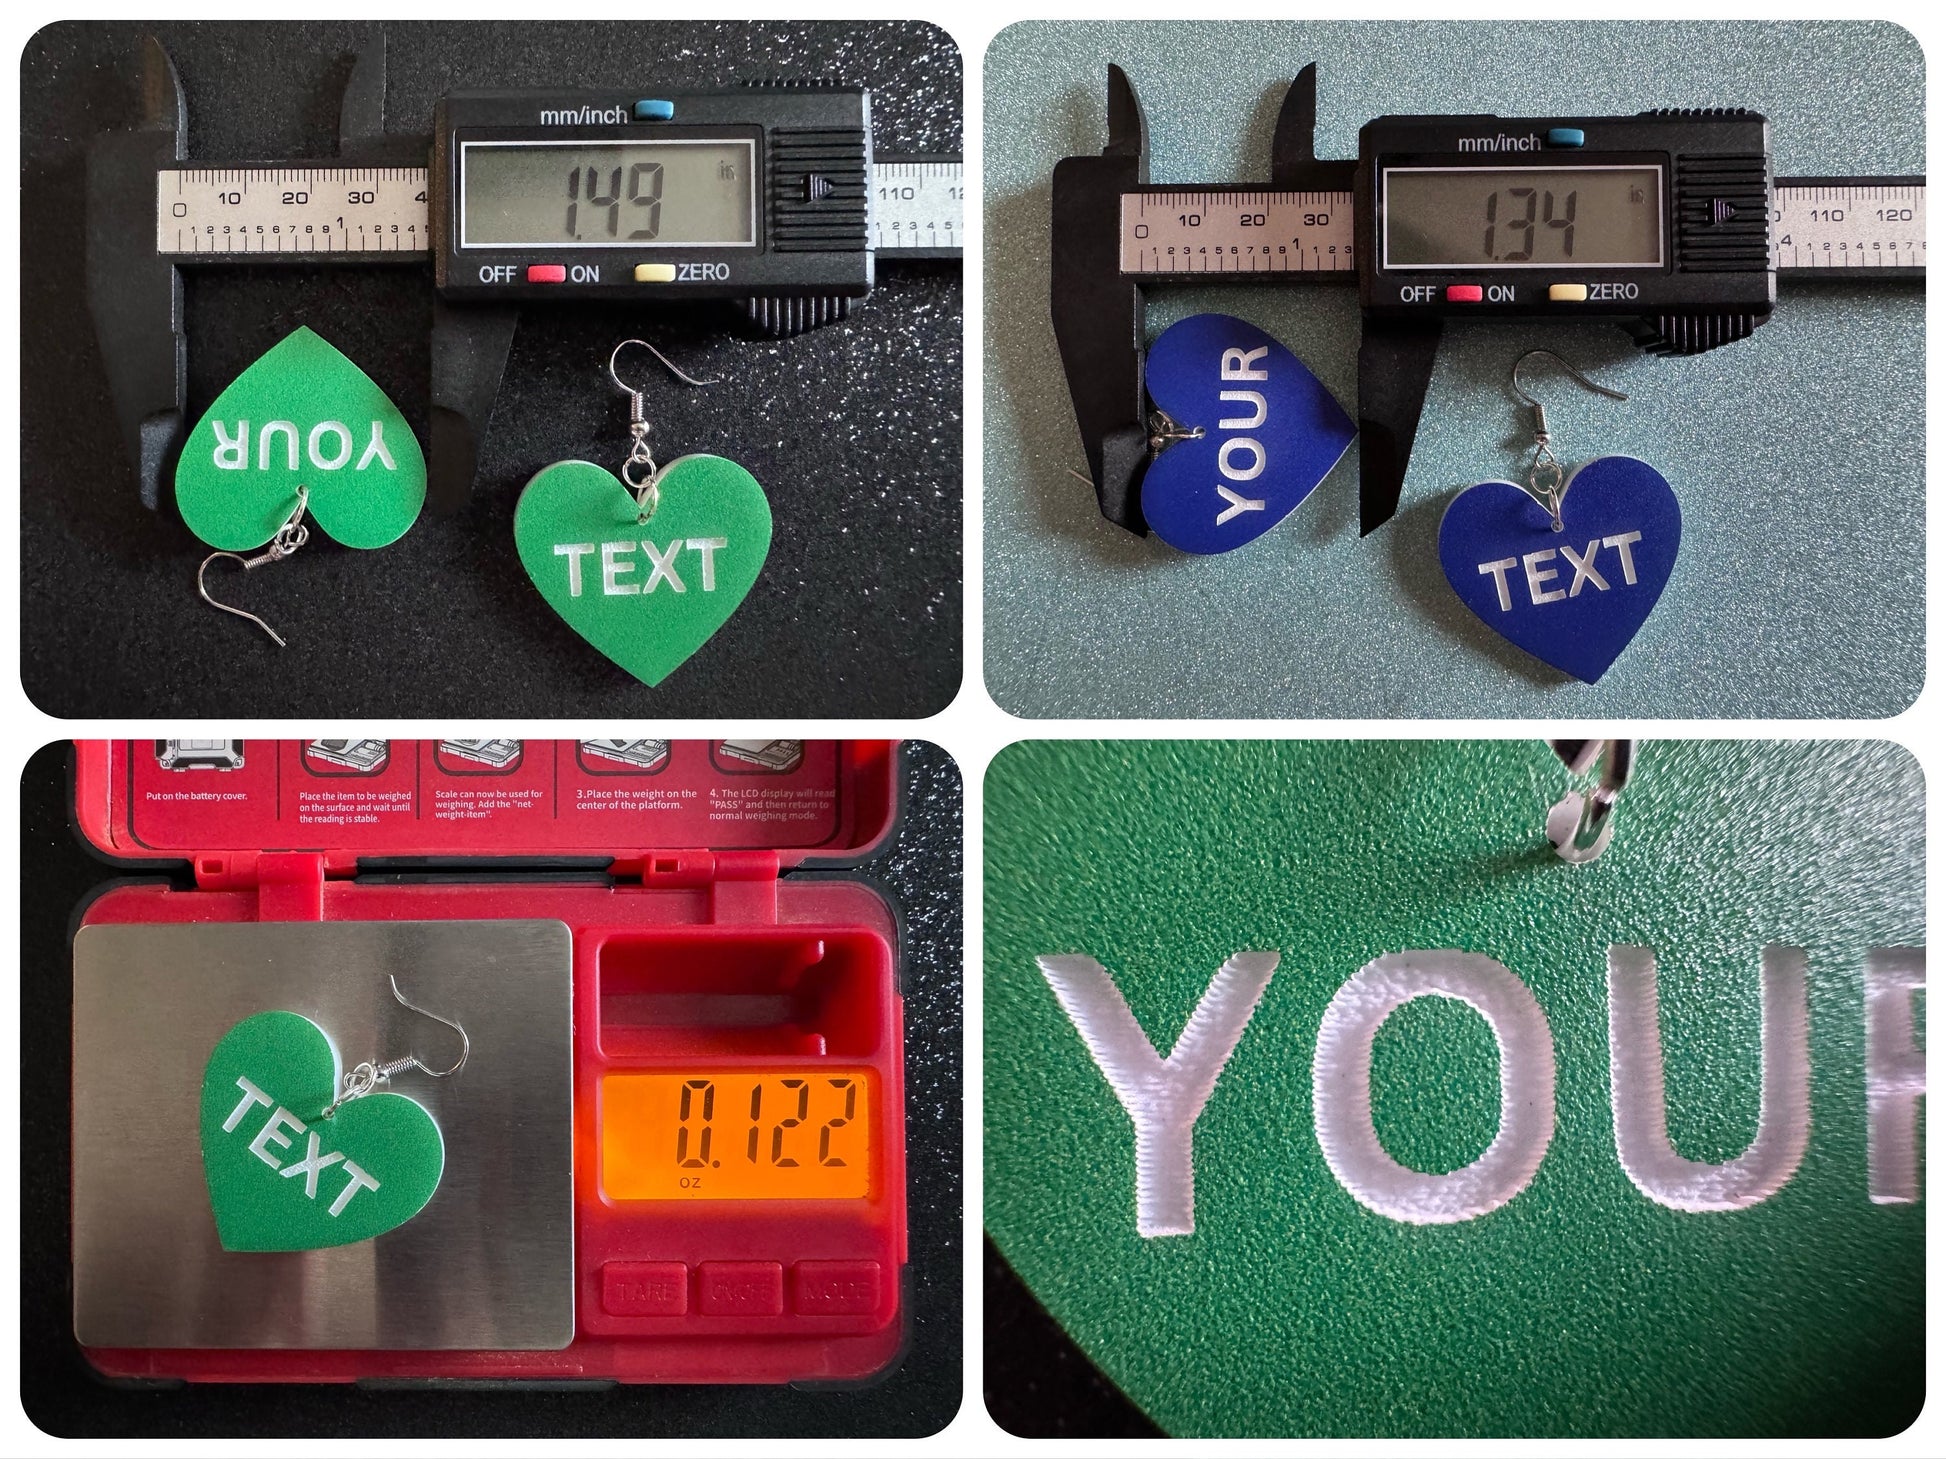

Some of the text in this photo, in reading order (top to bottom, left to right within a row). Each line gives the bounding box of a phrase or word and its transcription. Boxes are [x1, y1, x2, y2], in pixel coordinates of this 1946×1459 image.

[541, 105, 628, 126] mm/inch
[1458, 134, 1542, 152] mm/inch
[218, 192, 242, 205] 10
[282, 191, 309, 205] 20
[348, 191, 375, 204] 30
[879, 187, 915, 201] 110
[566, 162, 664, 240] 1.49
[172, 202, 187, 218] 0
[1810, 209, 1913, 222] 110 120
[337, 216, 344, 230] 1
[875, 221, 881, 230] 1
[892, 221, 900, 230] 2
[909, 221, 917, 230] 3
[926, 221, 934, 230] 4
[944, 221, 952, 230] 5
[1179, 213, 1329, 227] 10 20 30
[1484, 187, 1577, 262] 1.34
[191, 226, 330, 234] 1 2 3 4 5 6 7 8 9
[358, 225, 363, 234] 1
[374, 225, 382, 234] 2
[390, 225, 399, 234] 3
[407, 225, 415, 234] 4
[1135, 224, 1149, 239] 0
[1292, 238, 1300, 250] 1
[1780, 234, 1792, 247] 4
[1807, 242, 1812, 250] 1
[1823, 242, 1831, 250] 2
[1839, 242, 1847, 250] 3
[1856, 242, 1864, 250] 4
[1873, 242, 1880, 250] 5
[1889, 242, 1897, 250] 6
[1906, 242, 1913, 250] 7
[1313, 246, 1352, 254] 1 2 3
[479, 262, 730, 284] OFF ON ZERO
[1400, 282, 1639, 303] OFF ON ZERO
[1216, 345, 1269, 526] YOUR
[211, 419, 397, 472] YOUR
[553, 537, 728, 598] TEXT
[1477, 530, 1643, 613] TEXT
[146, 791, 161, 800] Put
[175, 791, 189, 800] the
[190, 791, 221, 802] battery
[222, 792, 248, 800] cover.
[299, 791, 412, 802] Place the item to be weighed
[435, 789, 543, 799] Scale can now be used for
[614, 789, 630, 799] the
[632, 789, 664, 801] weight
[666, 790, 679, 799] on
[681, 789, 697, 798] the
[709, 788, 836, 800] 4. The LCD display will read
[299, 802, 411, 812] on the surface and wait until
[435, 800, 477, 810] weighing.
[478, 800, 495, 809] Add
[496, 799, 511, 809] the
[576, 800, 684, 812] center of the platform.
[709, 800, 829, 809] "PASS" and then return to
[299, 814, 381, 825] the reading is stable.
[709, 811, 819, 822] normal weighing mode.
[676, 1078, 857, 1169] 0.122
[221, 1075, 382, 1218] TEXT
